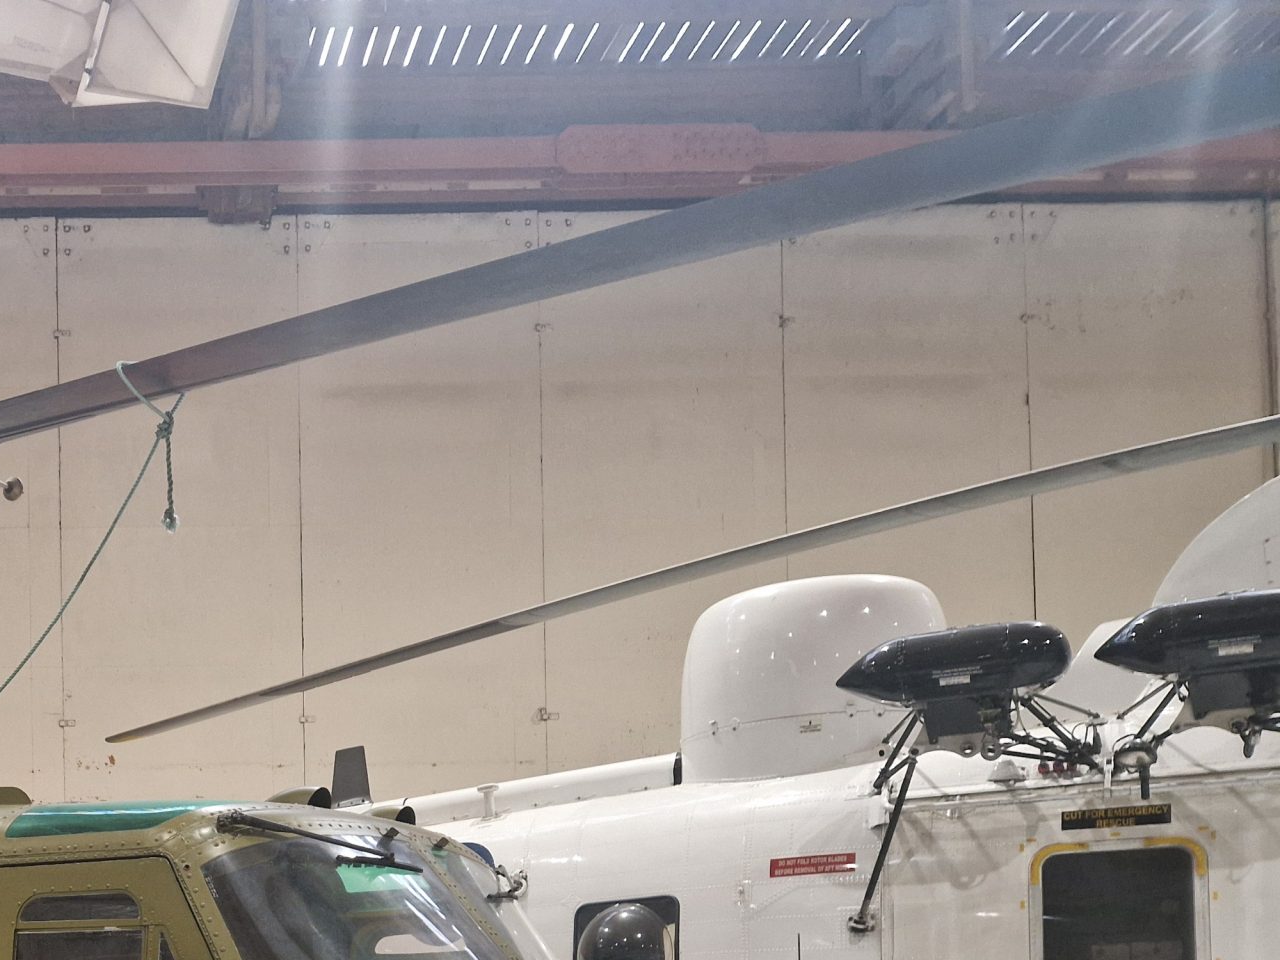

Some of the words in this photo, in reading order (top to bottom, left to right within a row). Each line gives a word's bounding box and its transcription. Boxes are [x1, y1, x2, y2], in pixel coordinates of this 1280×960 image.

[1085, 809, 1105, 819] FOR
[1107, 804, 1169, 818] EMERGENCY
[1096, 817, 1136, 828] RESCUE
